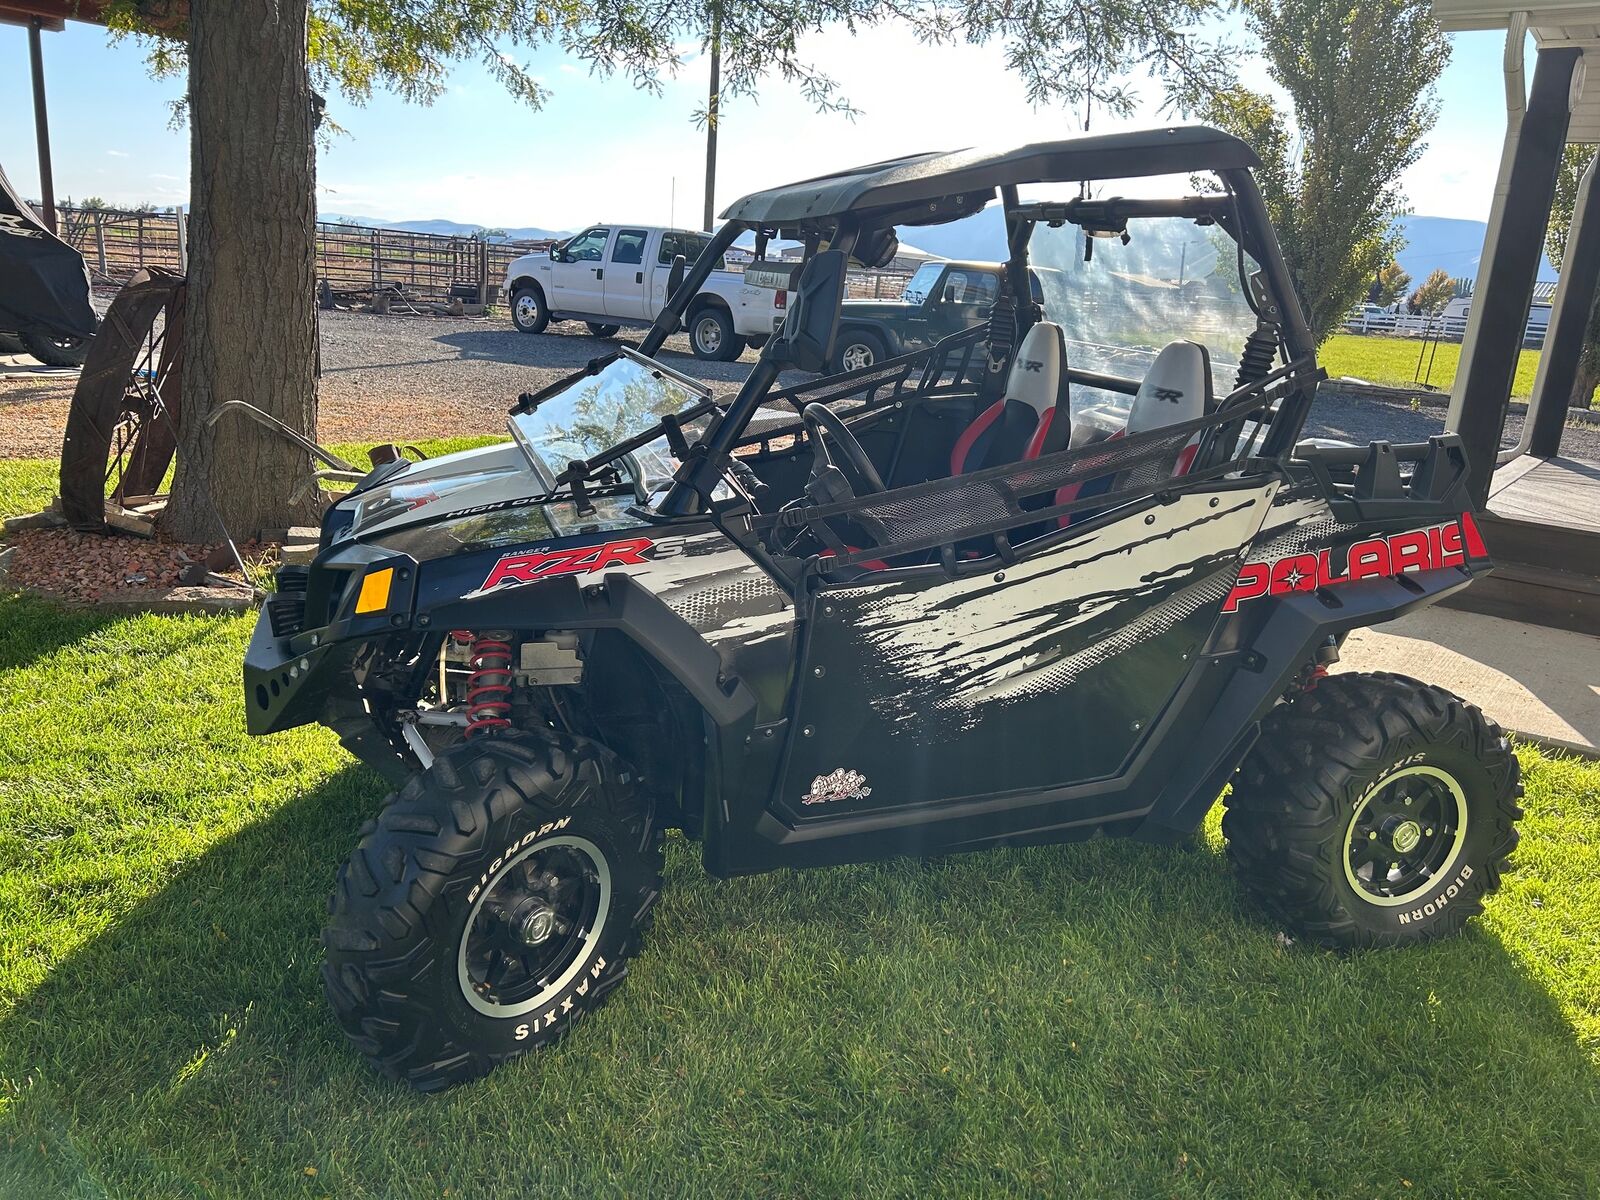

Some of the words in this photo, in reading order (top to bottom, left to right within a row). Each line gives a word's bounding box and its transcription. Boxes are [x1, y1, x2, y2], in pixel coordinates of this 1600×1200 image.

[446, 501, 505, 518] HIGH
[480, 537, 655, 592] RZR
[653, 539, 686, 558] S
[502, 546, 551, 558] RANGER
[1220, 518, 1467, 614] POLARIS
[1353, 752, 1426, 811] MAXXIS
[465, 815, 573, 905] BIGHORN
[1397, 864, 1475, 926] BIGHORN
[513, 955, 608, 1041] MAXXIS
